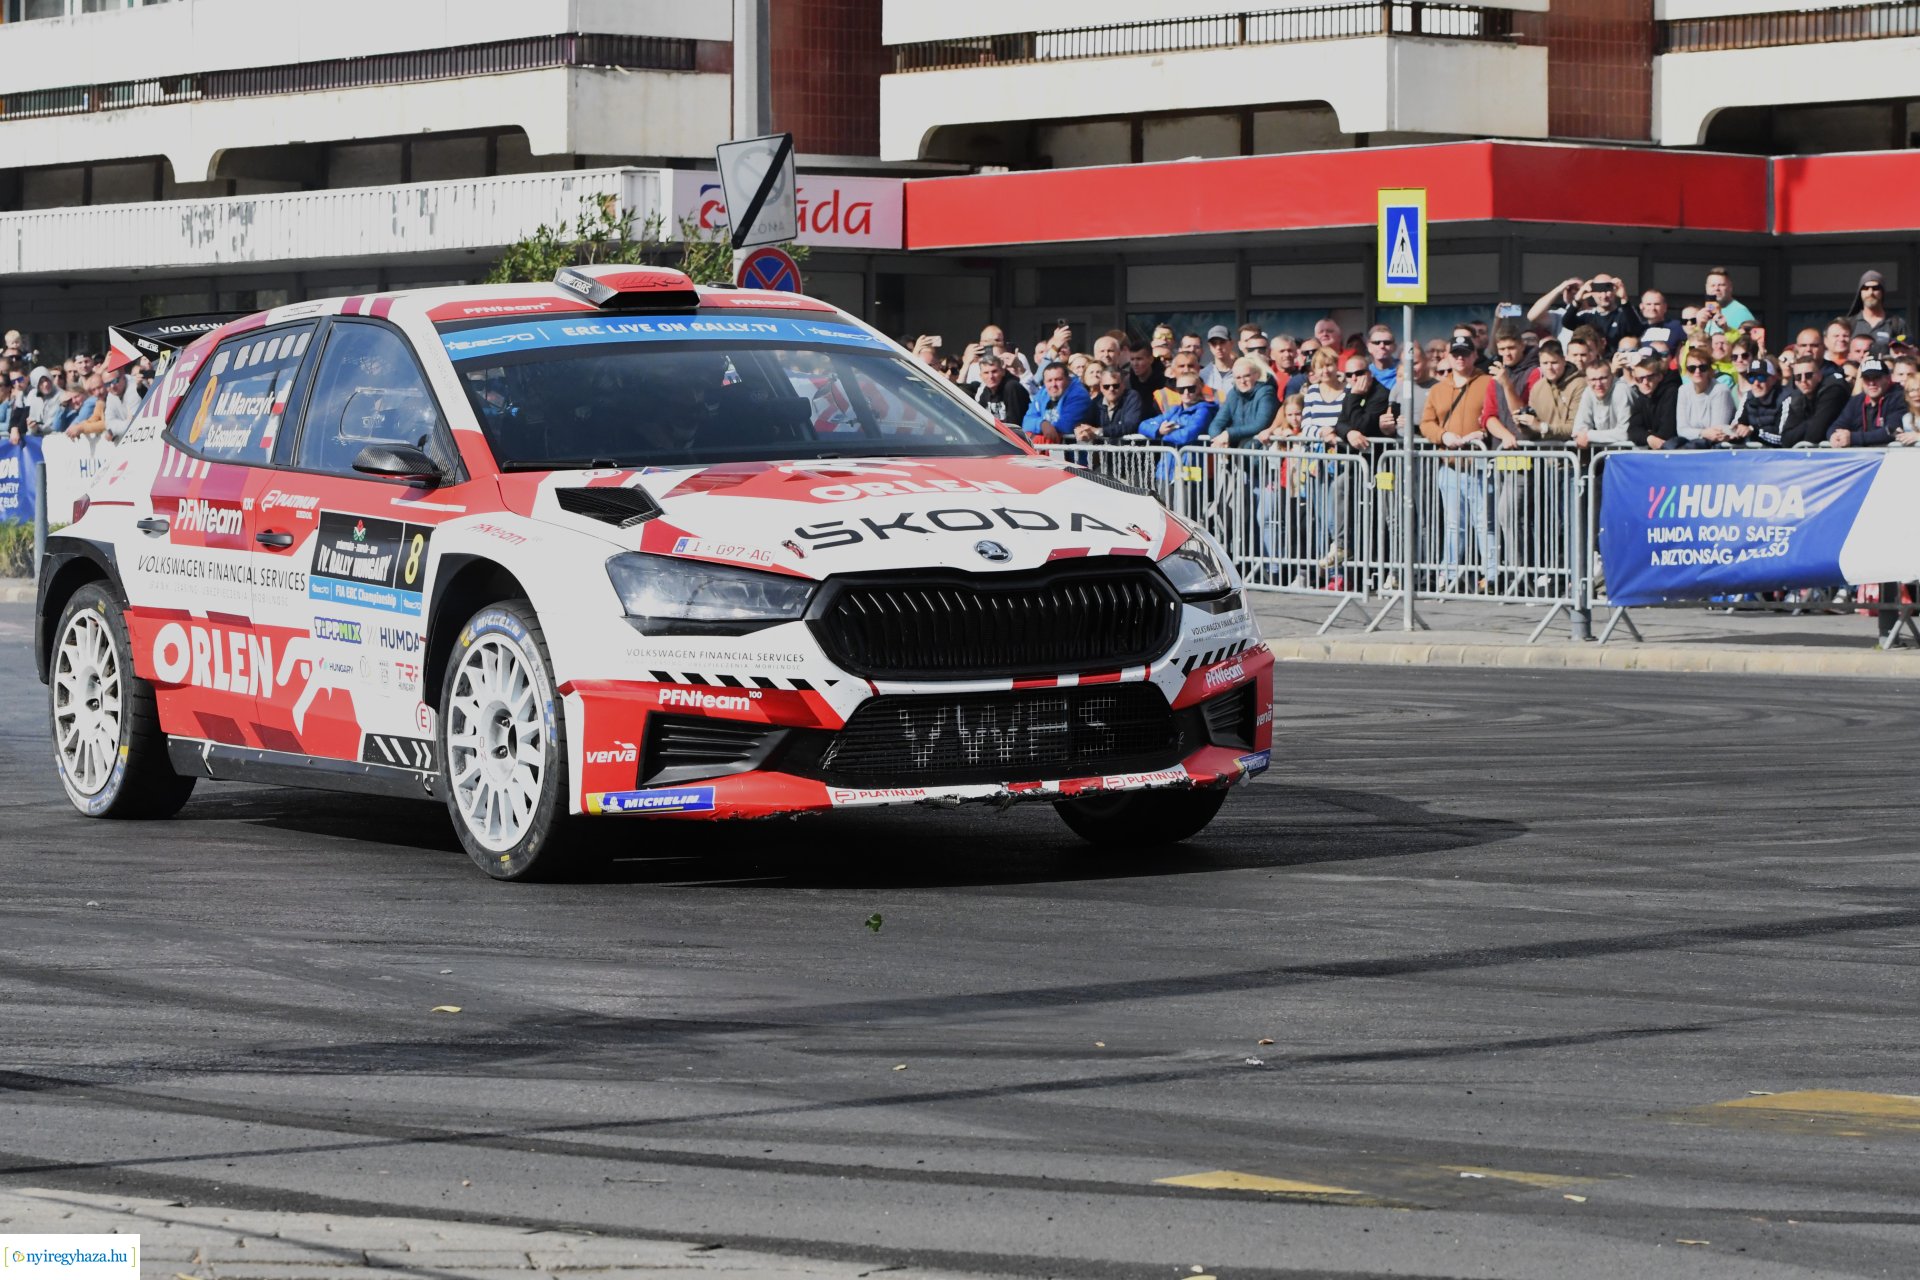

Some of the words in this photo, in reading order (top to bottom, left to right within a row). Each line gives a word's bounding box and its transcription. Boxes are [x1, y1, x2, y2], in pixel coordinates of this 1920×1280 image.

[561, 326, 605, 337] ERC
[608, 323, 655, 334] LIVE
[657, 322, 688, 333] ON
[690, 322, 778, 334] RALLY.TV
[189, 375, 219, 445] 8
[276, 493, 321, 509] PLATINUM
[809, 480, 1022, 501] ORLEN
[1677, 484, 1806, 519] HUMDA
[174, 498, 244, 536] PFNteam
[1647, 526, 1694, 544] HUMDA
[1698, 525, 1740, 542] ROAD
[404, 533, 424, 585] 8
[1650, 551, 1661, 567] A
[138, 554, 206, 579] VOLKSWAGEN
[208, 561, 258, 586] FINANCIAL
[260, 568, 306, 592] SERVICES
[379, 627, 420, 653] HUMDA
[153, 622, 273, 699] ORLEN
[626, 649, 696, 659] VOLKSWAGEN
[699, 651, 754, 661] FINANCIAL
[757, 652, 805, 663] SERVICES
[1205, 663, 1244, 688] PFNteam
[658, 688, 751, 711] PFNteam
[586, 748, 637, 764] verva
[1126, 770, 1185, 785] PLATINUM
[623, 794, 700, 809] MICHELIN
[858, 788, 927, 799] PLATINUM
